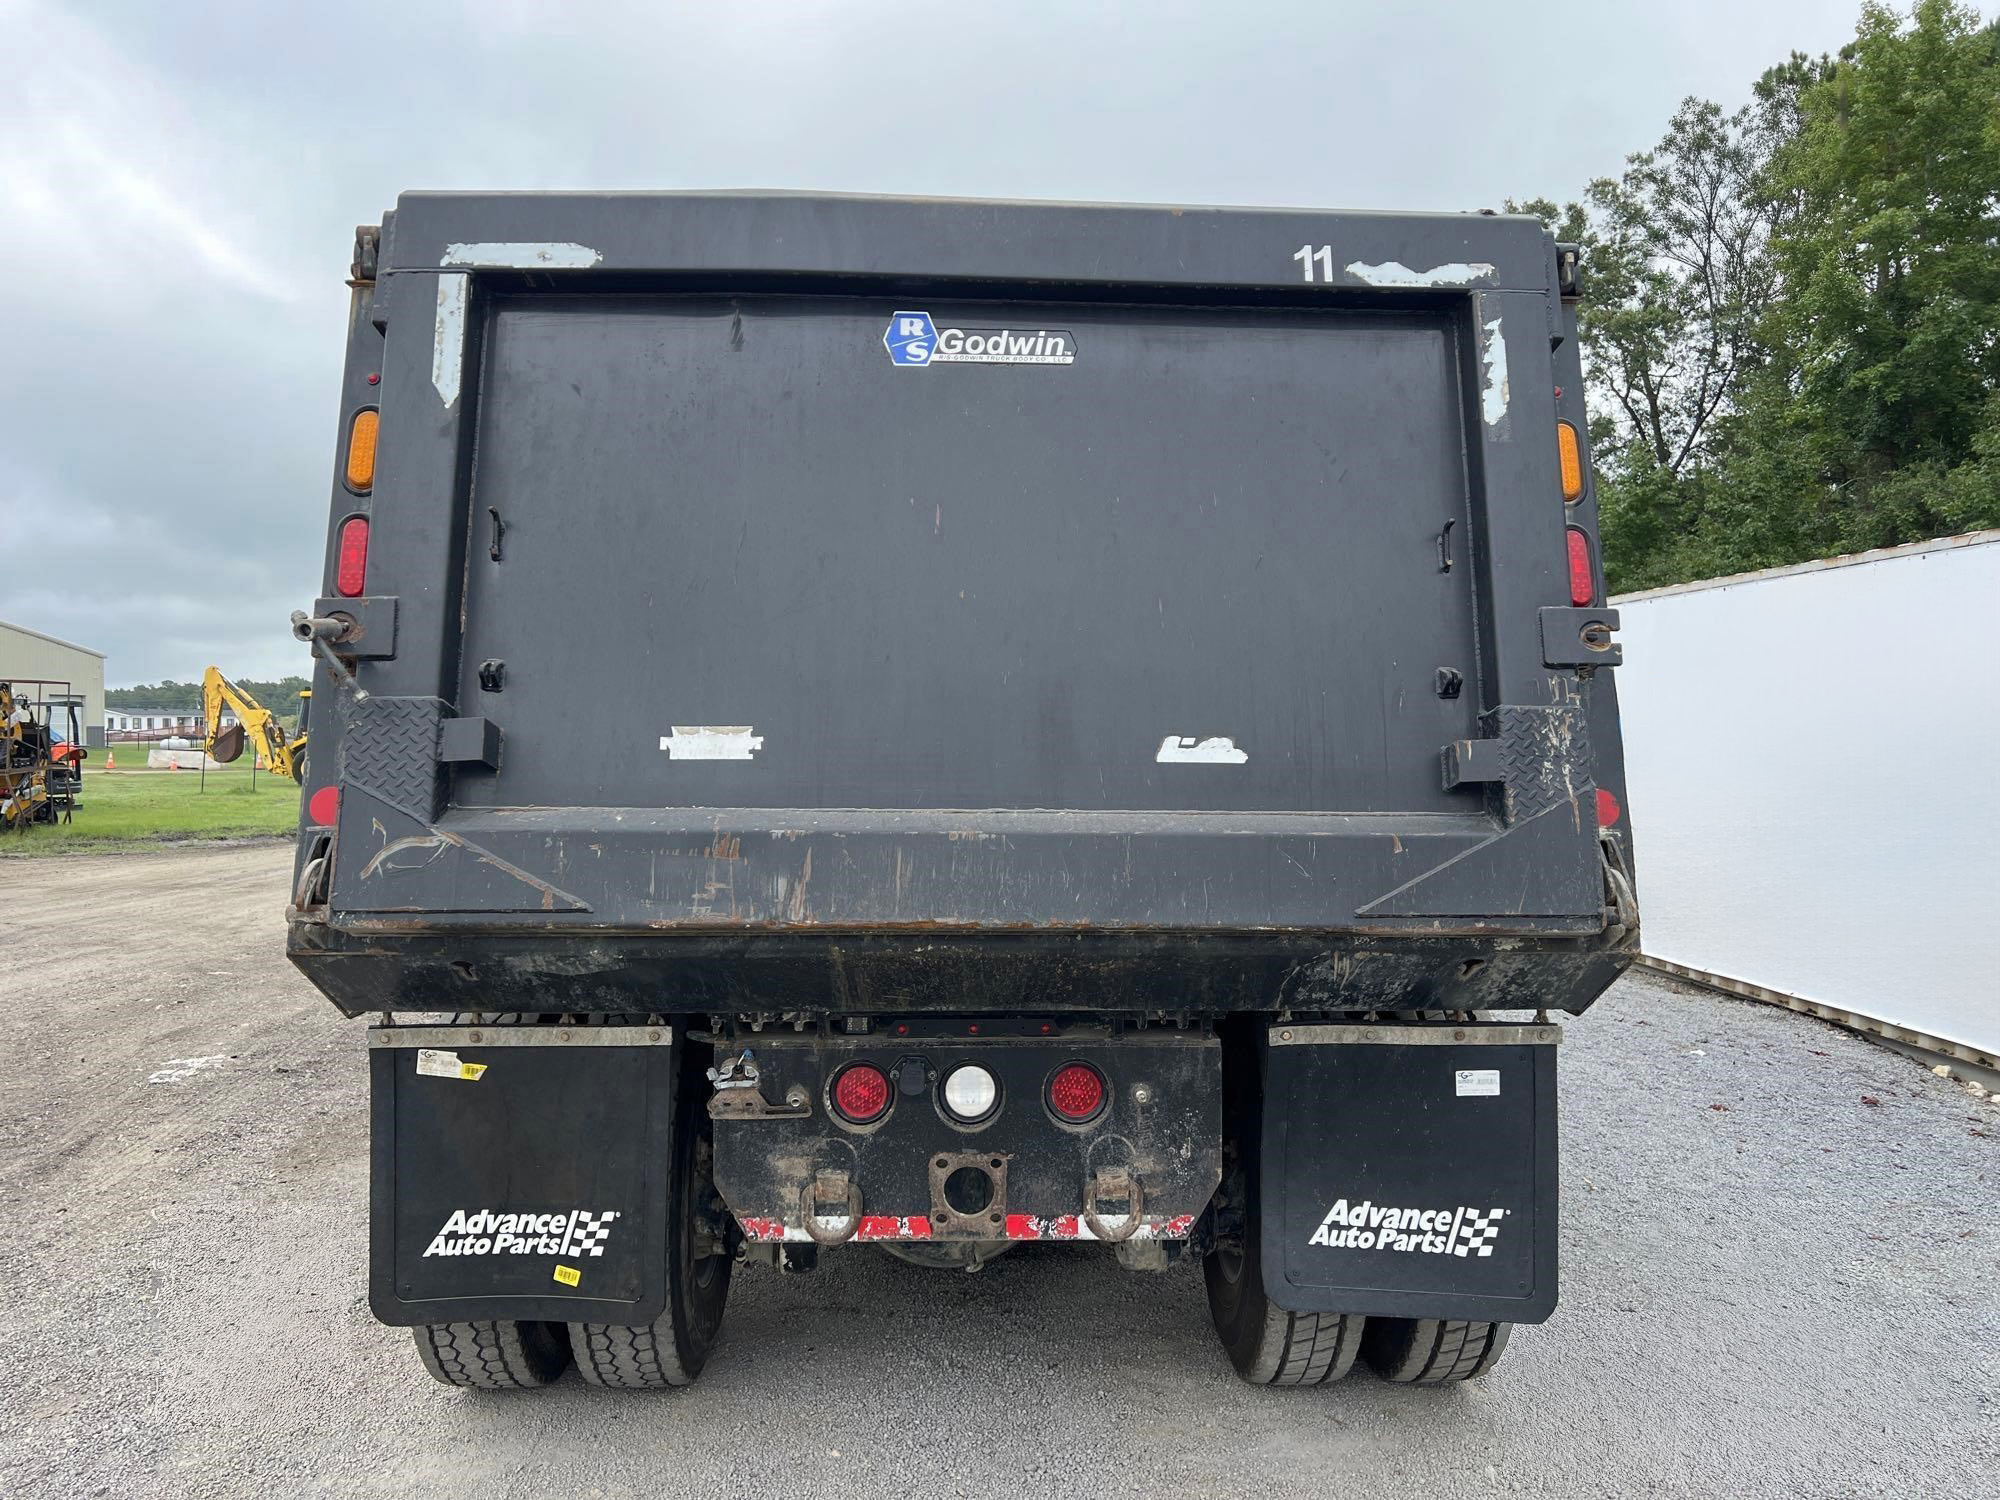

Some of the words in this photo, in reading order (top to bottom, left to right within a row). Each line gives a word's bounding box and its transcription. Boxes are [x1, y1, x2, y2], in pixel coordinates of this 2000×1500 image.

[1294, 245, 1333, 282] 11
[900, 318, 925, 336] R
[906, 342, 928, 361] S
[939, 329, 1065, 355] Godwin
[439, 1209, 567, 1235] Advance
[1322, 1199, 1453, 1232] Advance
[422, 1235, 492, 1257] Auto
[492, 1233, 561, 1255] Parts
[1308, 1224, 1376, 1250] Auto
[1375, 1228, 1447, 1254] Parts
